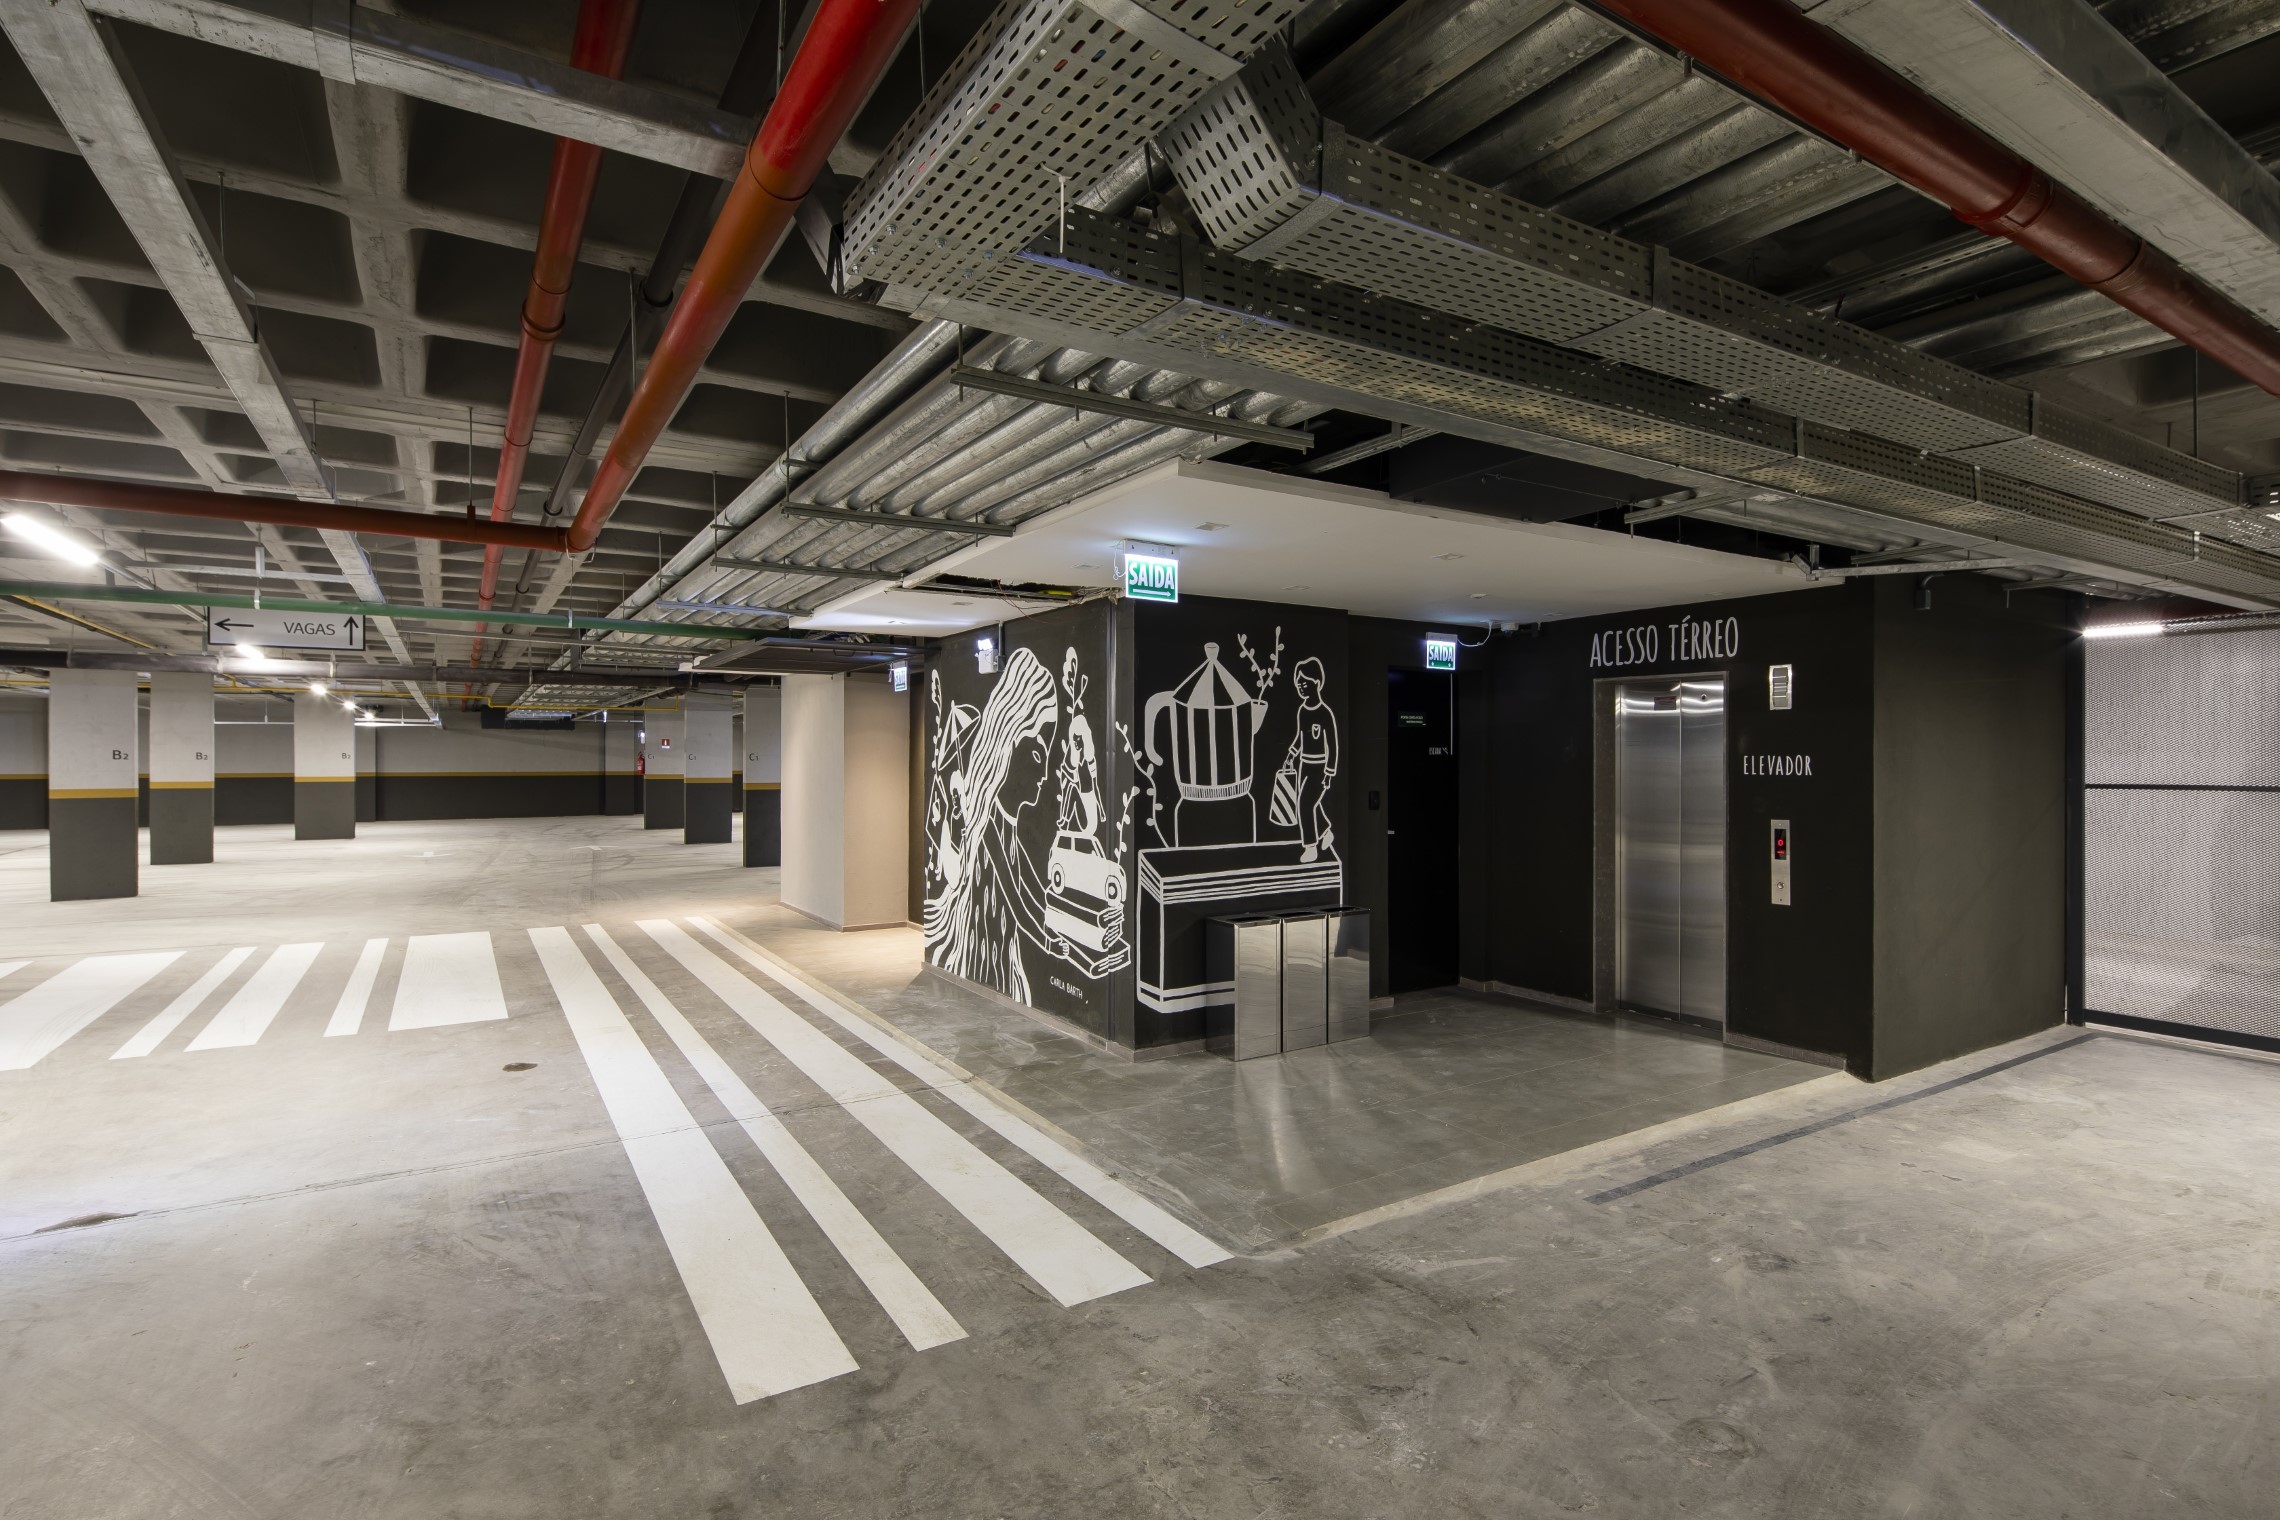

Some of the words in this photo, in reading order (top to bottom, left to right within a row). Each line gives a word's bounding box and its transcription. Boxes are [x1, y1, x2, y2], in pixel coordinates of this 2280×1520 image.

[283, 621, 336, 636] VAGAS
[1589, 624, 1659, 668] ACESSO
[1668, 614, 1739, 661] TÉRREO
[1743, 754, 1812, 776] ELEVADOR
[1049, 975, 1066, 991] CARLA
[1066, 982, 1083, 999] BARTH
